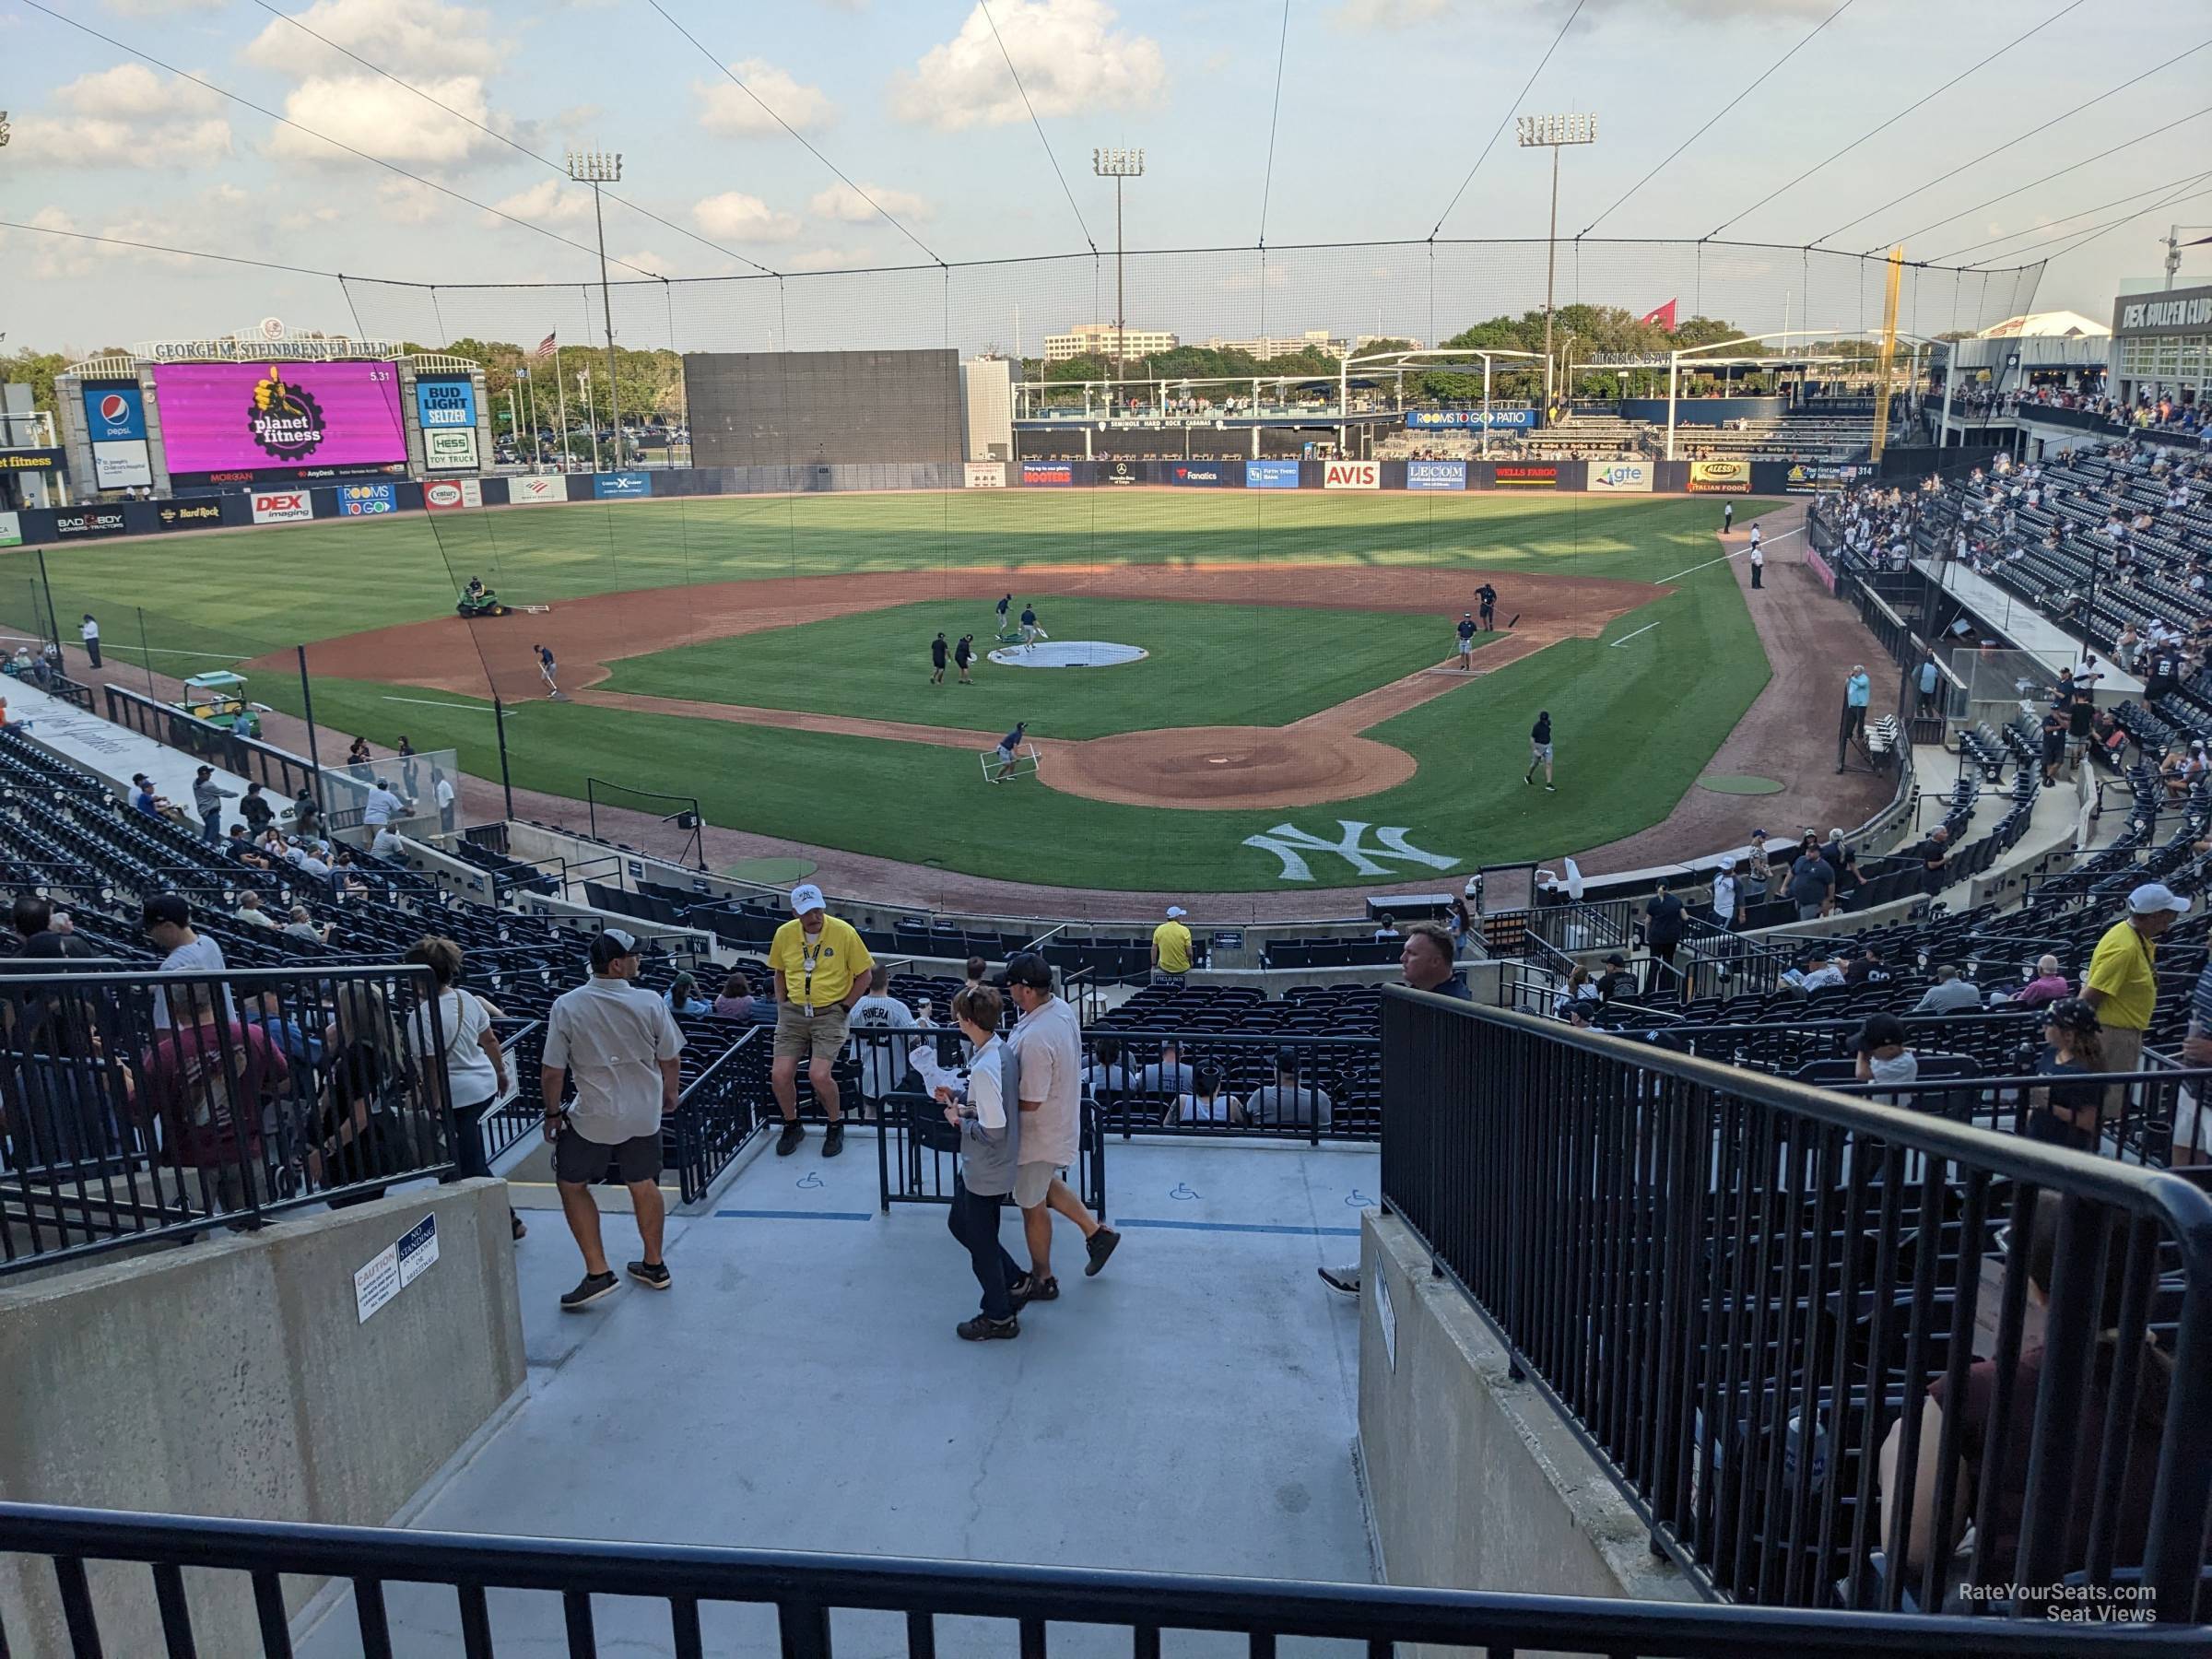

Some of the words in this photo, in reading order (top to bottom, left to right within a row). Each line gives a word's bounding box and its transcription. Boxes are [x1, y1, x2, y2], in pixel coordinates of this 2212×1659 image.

[2123, 303, 2147, 328] DEX
[2147, 300, 2187, 326] BULLPEN
[156, 343, 216, 359] GEORGE
[217, 342, 236, 357] M.
[240, 341, 347, 357] STEINBRENNER
[350, 342, 388, 356] FIELD
[429, 387, 461, 398] BUD
[424, 398, 467, 409] LIGHT
[429, 410, 466, 424] SELTZER
[1417, 413, 1453, 423] ROOMS
[1456, 413, 1469, 423] TO
[1497, 412, 1525, 423] PATIO
[254, 416, 309, 433] planet
[107, 428, 130, 436] pepsi
[264, 429, 321, 442] fitness
[436, 439, 465, 448] HESS
[10, 456, 52, 467] fitness
[307, 469, 335, 477] AnyDesk
[1327, 466, 1374, 485] AVIS
[1410, 466, 1463, 477] LECOM
[1496, 468, 1525, 477] WELLS
[1527, 468, 1557, 477] FARGO
[1615, 466, 1641, 482] gte
[1707, 465, 1735, 474] ALESSI
[1858, 467, 1873, 476] 314
[210, 472, 253, 483] MORGAN
[1024, 472, 1070, 482] HOOTERS
[1188, 472, 1217, 480] Fanatics
[344, 485, 389, 499] ROOMS
[430, 490, 457, 500] Century
[255, 495, 303, 512] DEX
[347, 502, 361, 514] TO
[363, 501, 384, 513] GO
[180, 508, 199, 518] Hard
[200, 506, 219, 517] Rock
[268, 509, 310, 519] imaging
[58, 518, 84, 527] BAD
[97, 515, 123, 524] BOY
[1241, 820, 1464, 881] NY
[862, 1006, 889, 1020] RIVERA
[410, 1225, 421, 1241] NO
[400, 1225, 433, 1260] STANDING
[357, 1249, 394, 1288] CAUTION
